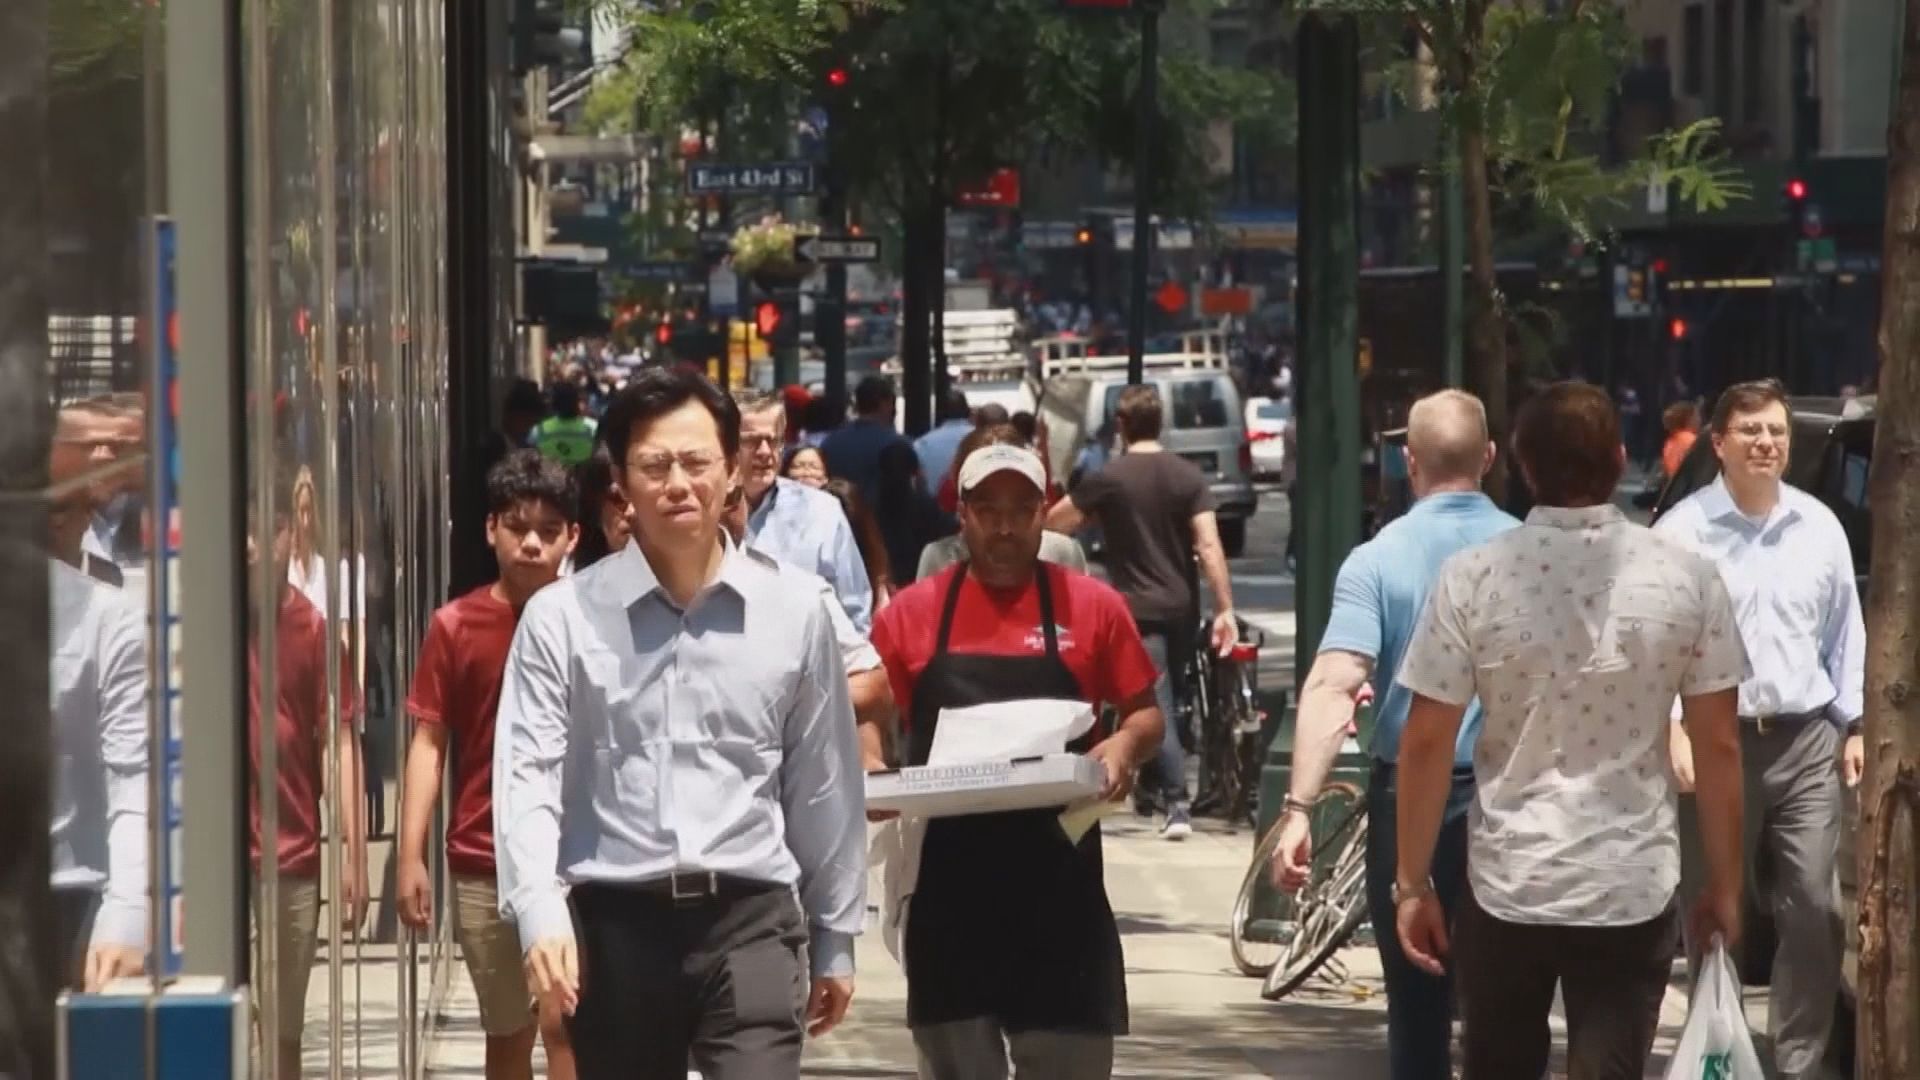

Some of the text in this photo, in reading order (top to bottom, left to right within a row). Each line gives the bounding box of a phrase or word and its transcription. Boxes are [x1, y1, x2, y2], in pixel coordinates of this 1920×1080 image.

[697, 168, 804, 187] East 43rd St
